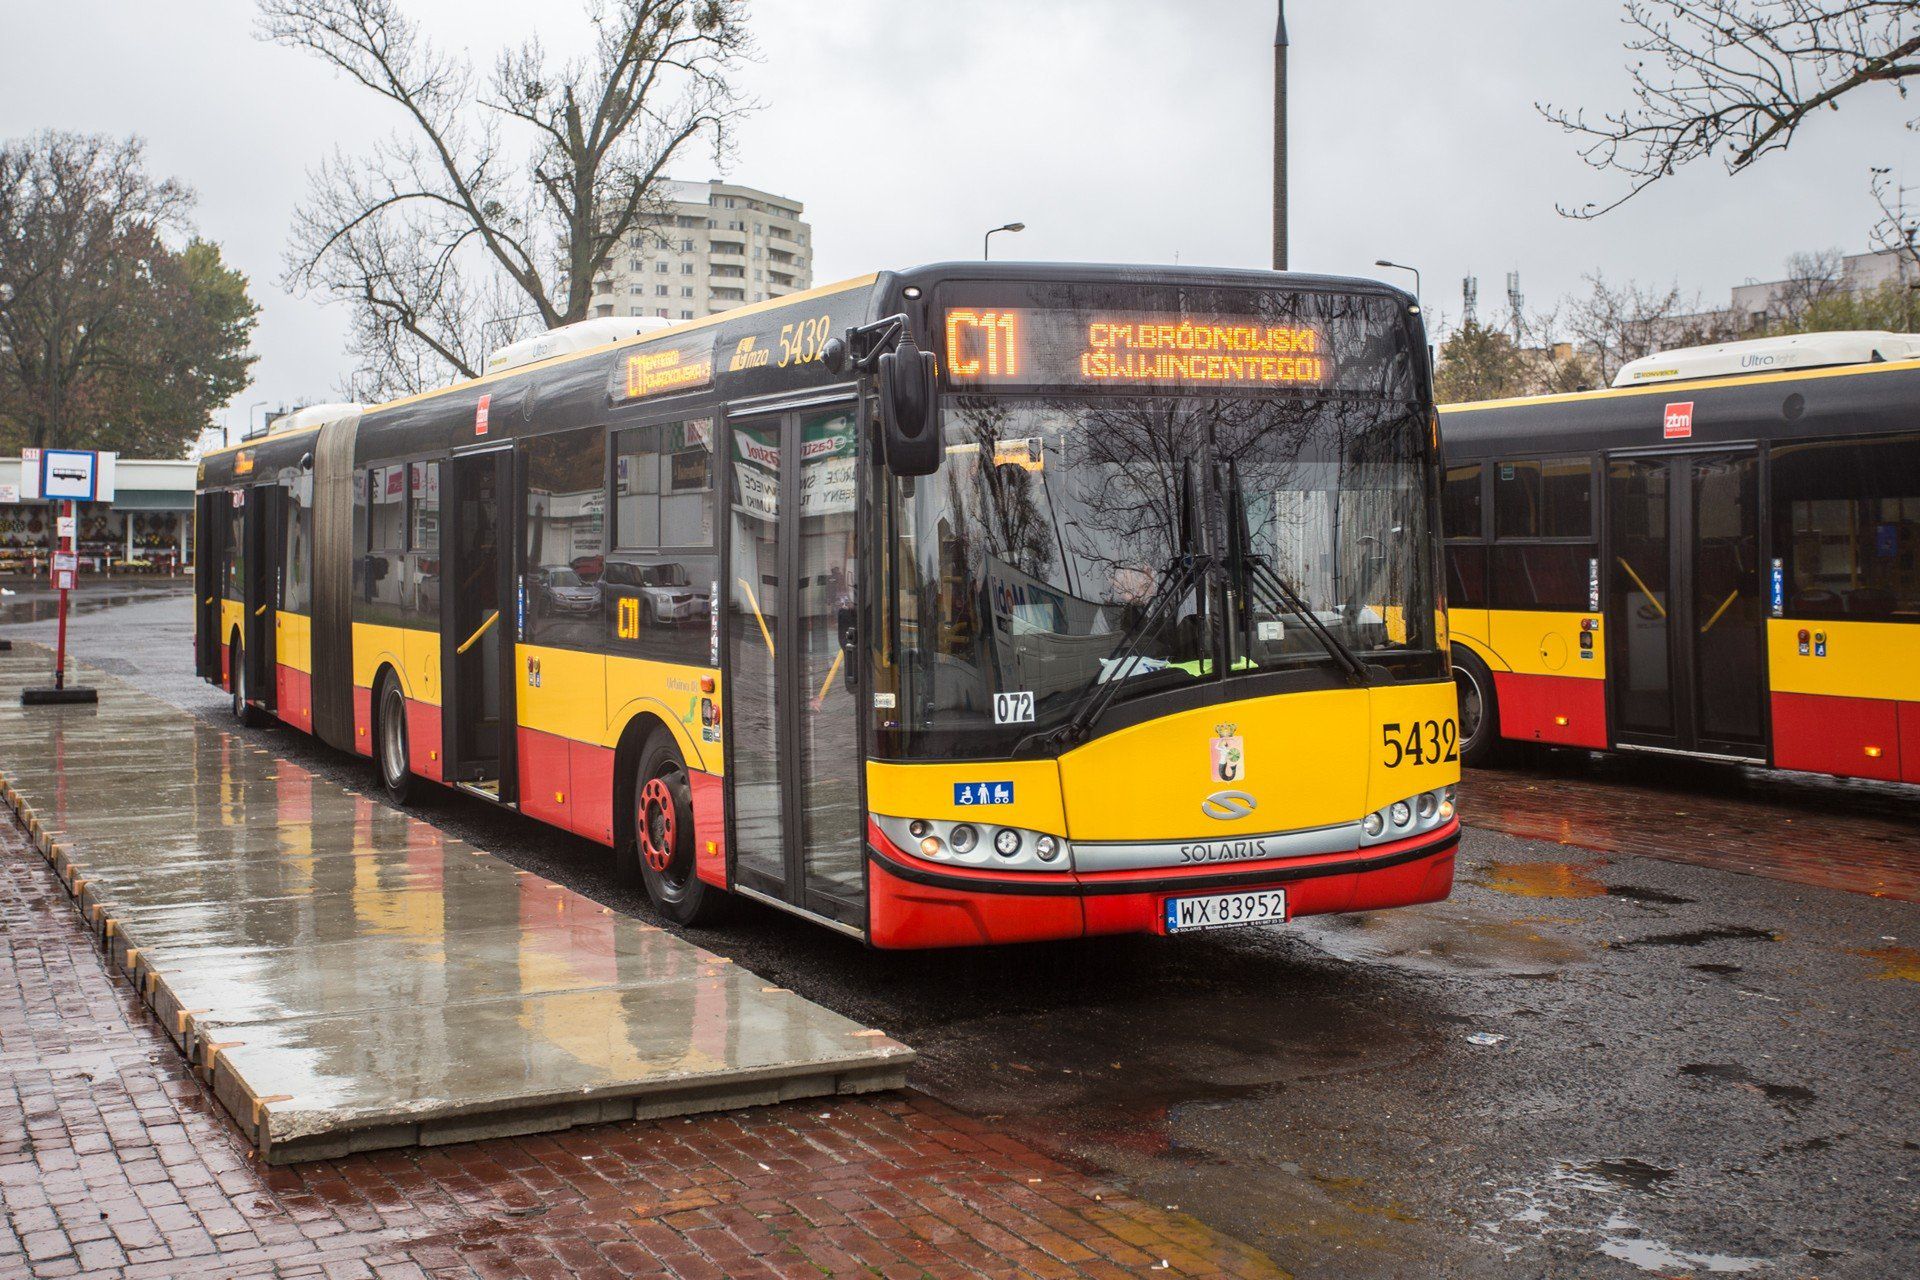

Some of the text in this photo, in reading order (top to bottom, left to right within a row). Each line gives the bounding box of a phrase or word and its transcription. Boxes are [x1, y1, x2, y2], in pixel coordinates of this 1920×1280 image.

[777, 315, 830, 368] 5432
[946, 309, 1017, 377] C11
[1089, 320, 1317, 352] CM.BRÓDNOWSKI
[1081, 350, 1321, 382] (ŚW.WINCENTEGO)
[1741, 354, 1774, 368] Ultra
[1666, 413, 1690, 428] ztm
[618, 597, 640, 639] C11
[997, 694, 1032, 722] 072
[1382, 718, 1459, 769] 5432
[1180, 840, 1267, 863] SOLARIS
[1181, 894, 1281, 924] WX 83952
